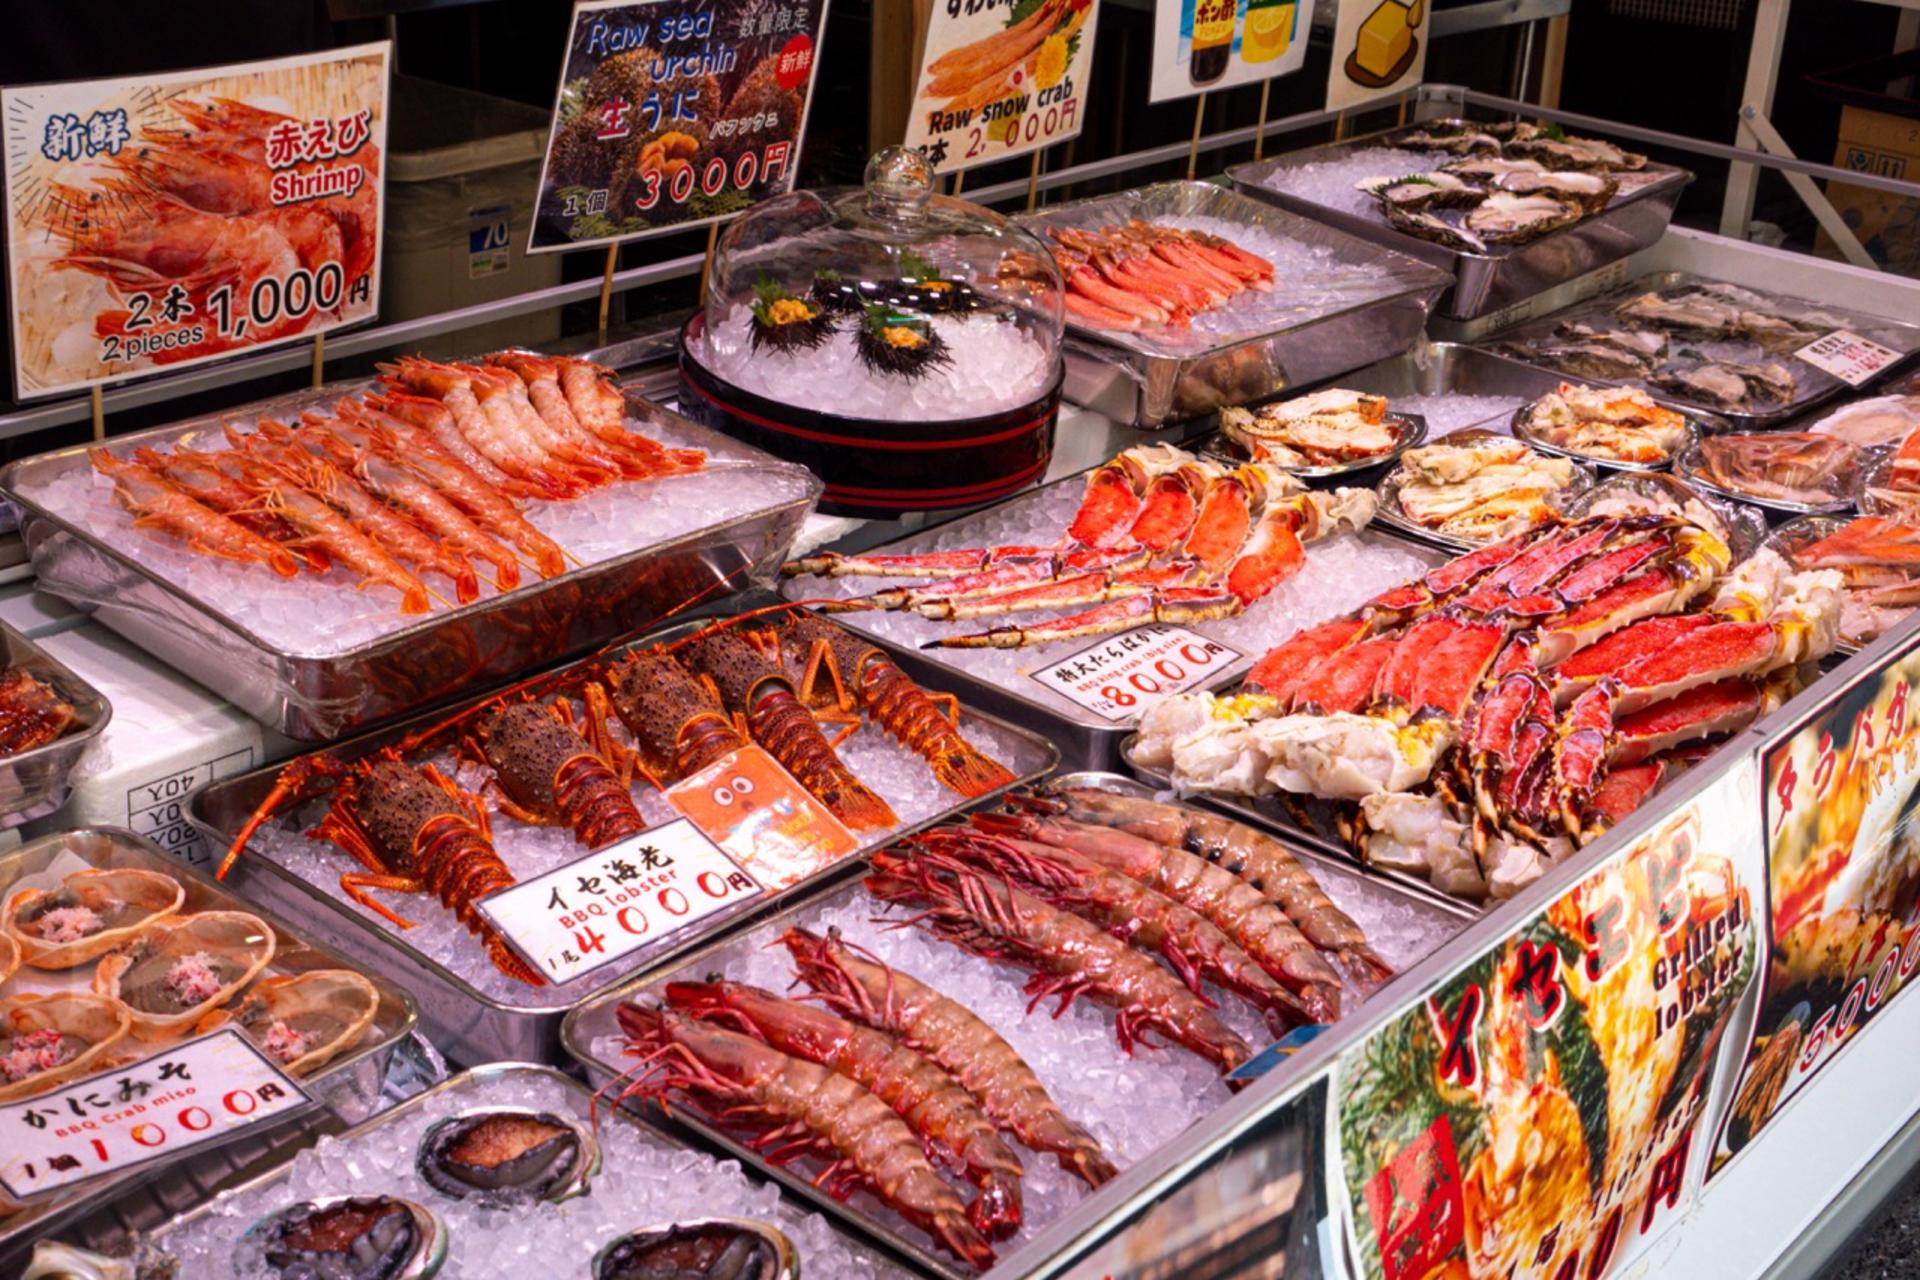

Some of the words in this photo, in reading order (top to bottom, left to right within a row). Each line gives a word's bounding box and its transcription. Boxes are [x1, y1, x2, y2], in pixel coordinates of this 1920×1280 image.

[588, 20, 648, 55] Raw
[658, 11, 714, 43] sea
[650, 43, 737, 83] urchin
[780, 49, 812, 75] 新鮮
[928, 108, 976, 136] Raw
[981, 94, 1031, 123] snow
[1037, 75, 1073, 108] crab
[41, 107, 131, 161] 新鮮
[266, 109, 372, 166] 赤えび
[271, 166, 364, 205] Shrimp
[636, 141, 791, 210] 3000円
[125, 287, 194, 333] 2本
[559, 901, 602, 930] BBQ
[605, 867, 679, 908] lobster
[572, 871, 752, 954] 4000円
[1653, 895, 1741, 991] Grilled
[1655, 945, 1743, 1040] lobster
[54, 1120, 100, 1139] BBQ
[102, 1103, 147, 1125] Crab
[152, 1087, 198, 1108] miso
